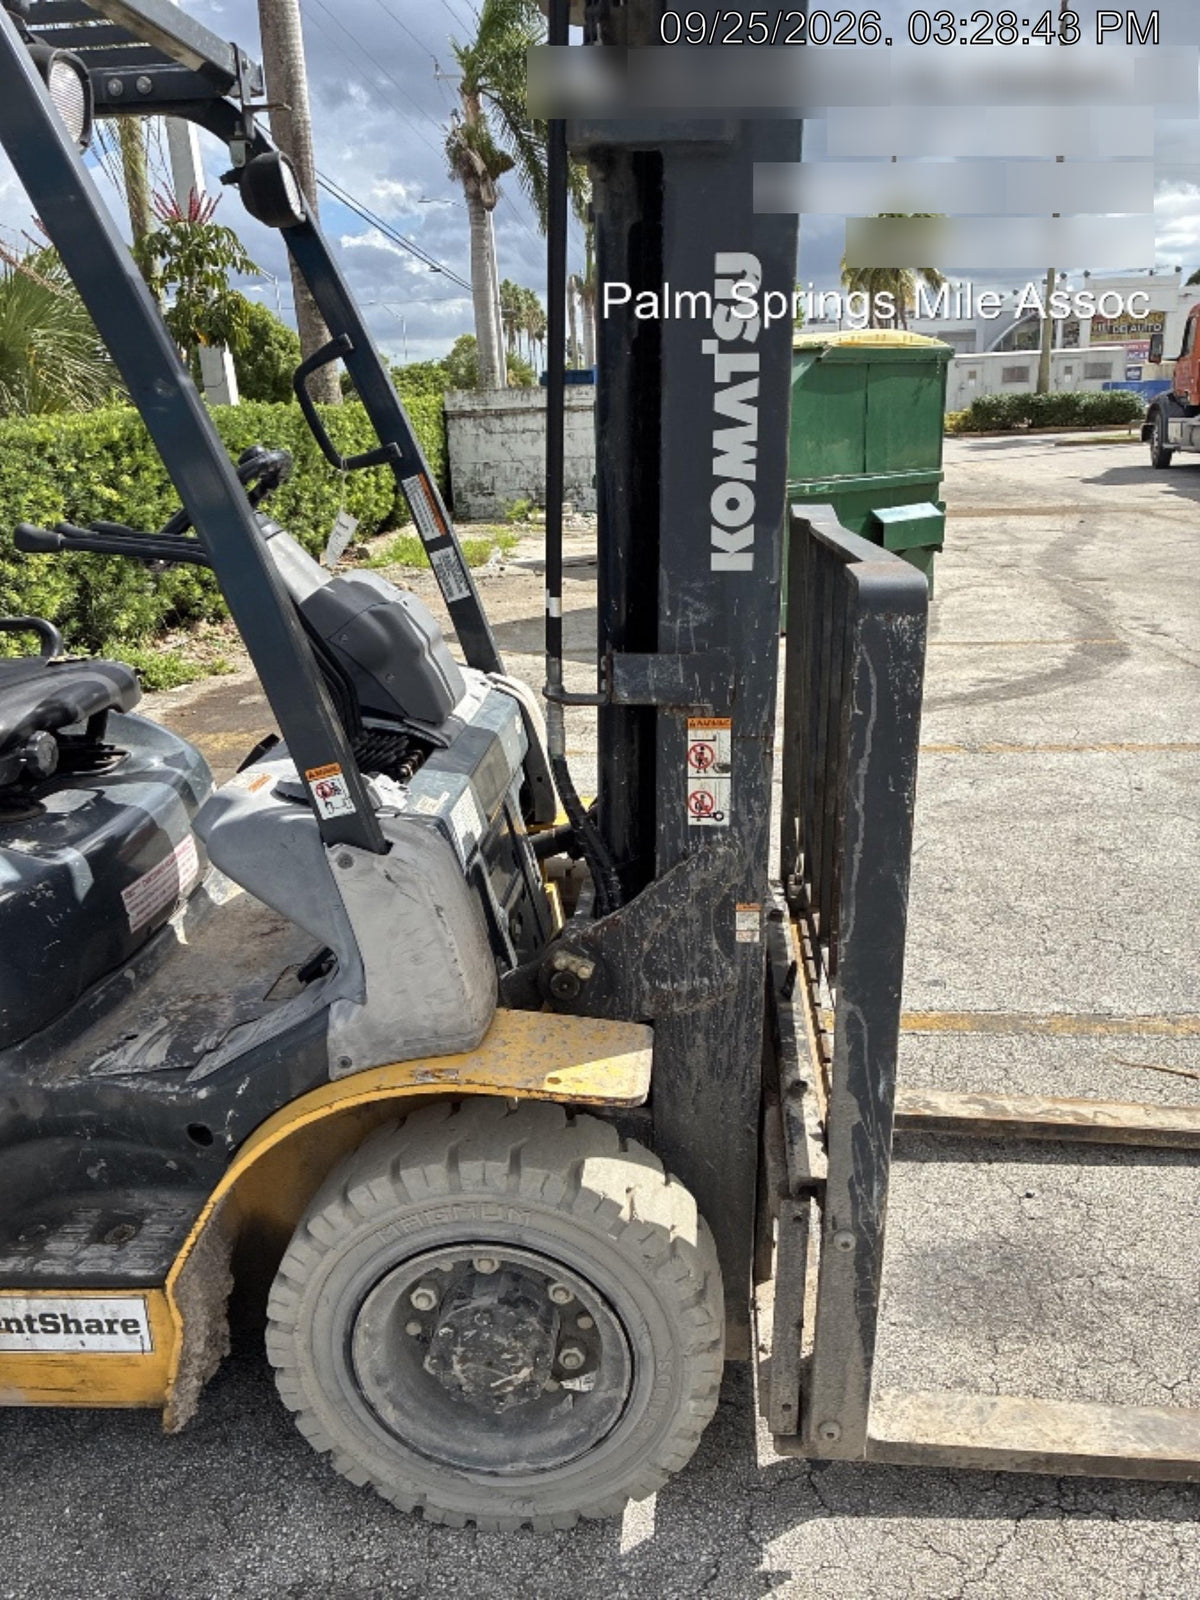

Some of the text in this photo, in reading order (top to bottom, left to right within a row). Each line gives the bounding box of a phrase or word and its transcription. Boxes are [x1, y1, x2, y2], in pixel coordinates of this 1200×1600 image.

[701, 252, 763, 571] KOMATSU
[376, 1202, 532, 1246] MAGNUM
[0, 1312, 141, 1335] ntShare
